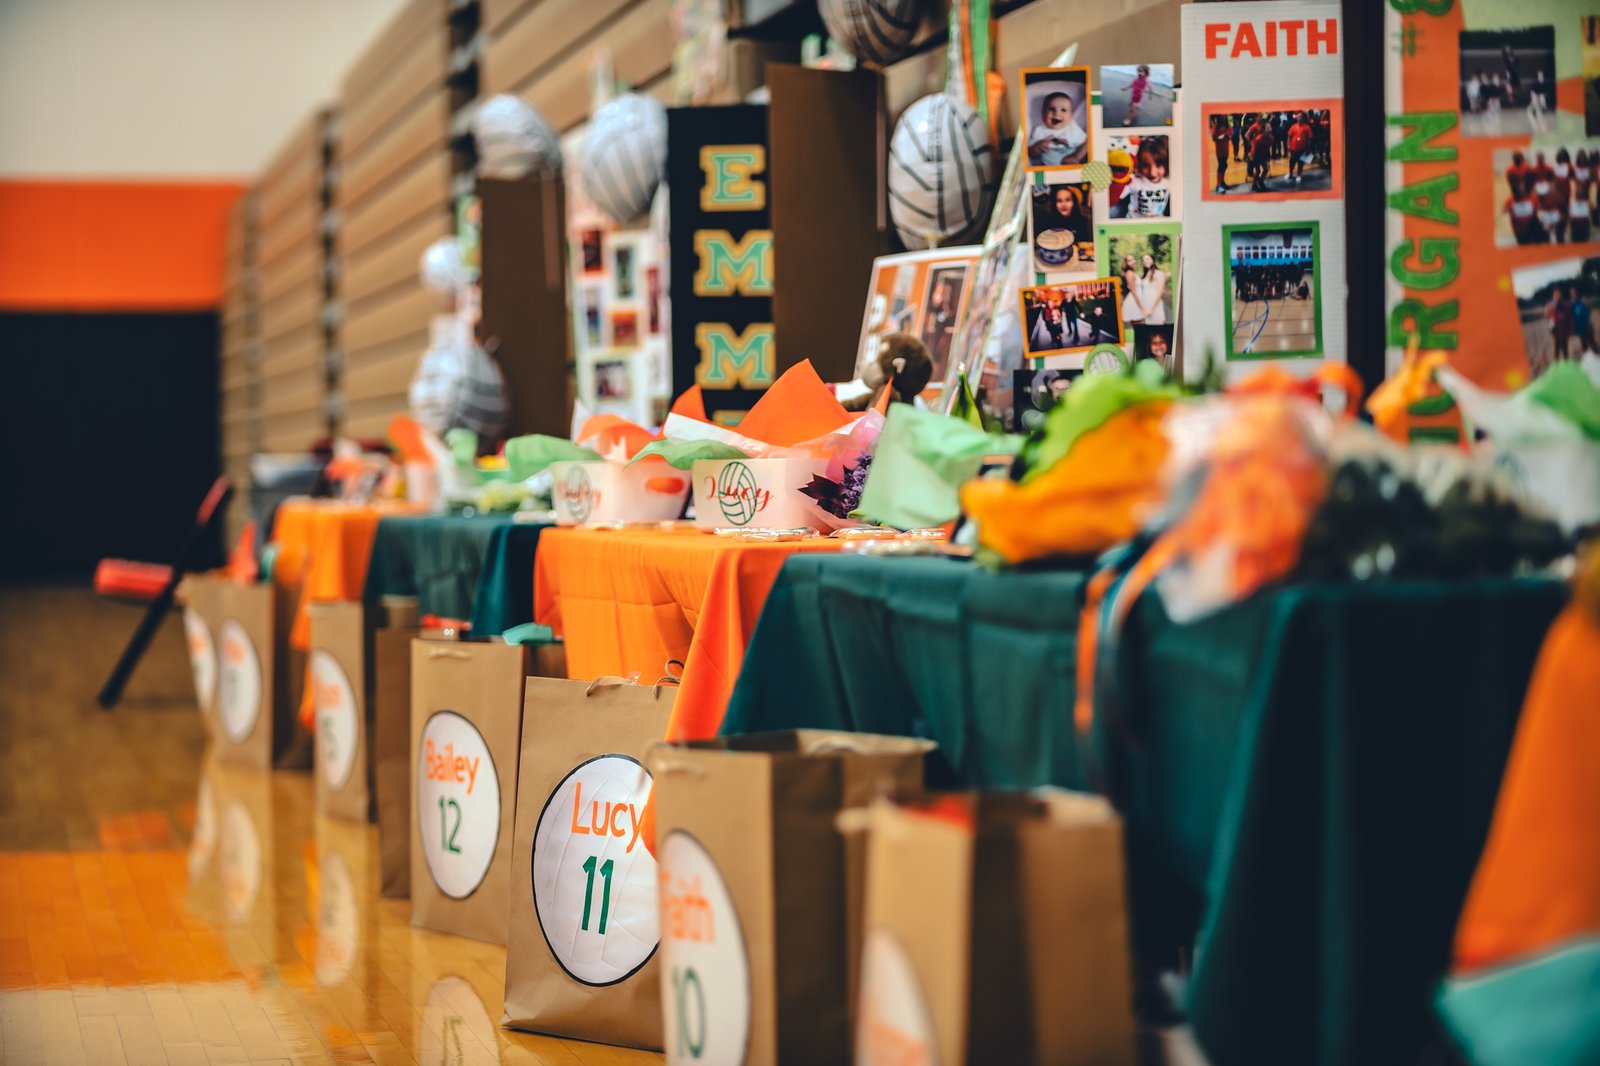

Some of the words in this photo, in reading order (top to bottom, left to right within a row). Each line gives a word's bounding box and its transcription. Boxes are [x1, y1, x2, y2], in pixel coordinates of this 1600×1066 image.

[1205, 18, 1338, 59] FAITH
[693, 143, 776, 426] EMM
[1386, 110, 1459, 442] RGAN
[703, 475, 774, 512] Lucy
[425, 737, 480, 797] Bailey
[438, 795, 461, 855] 12
[571, 782, 648, 853] Lucy
[581, 855, 614, 935] 11
[672, 965, 707, 1059] 10
